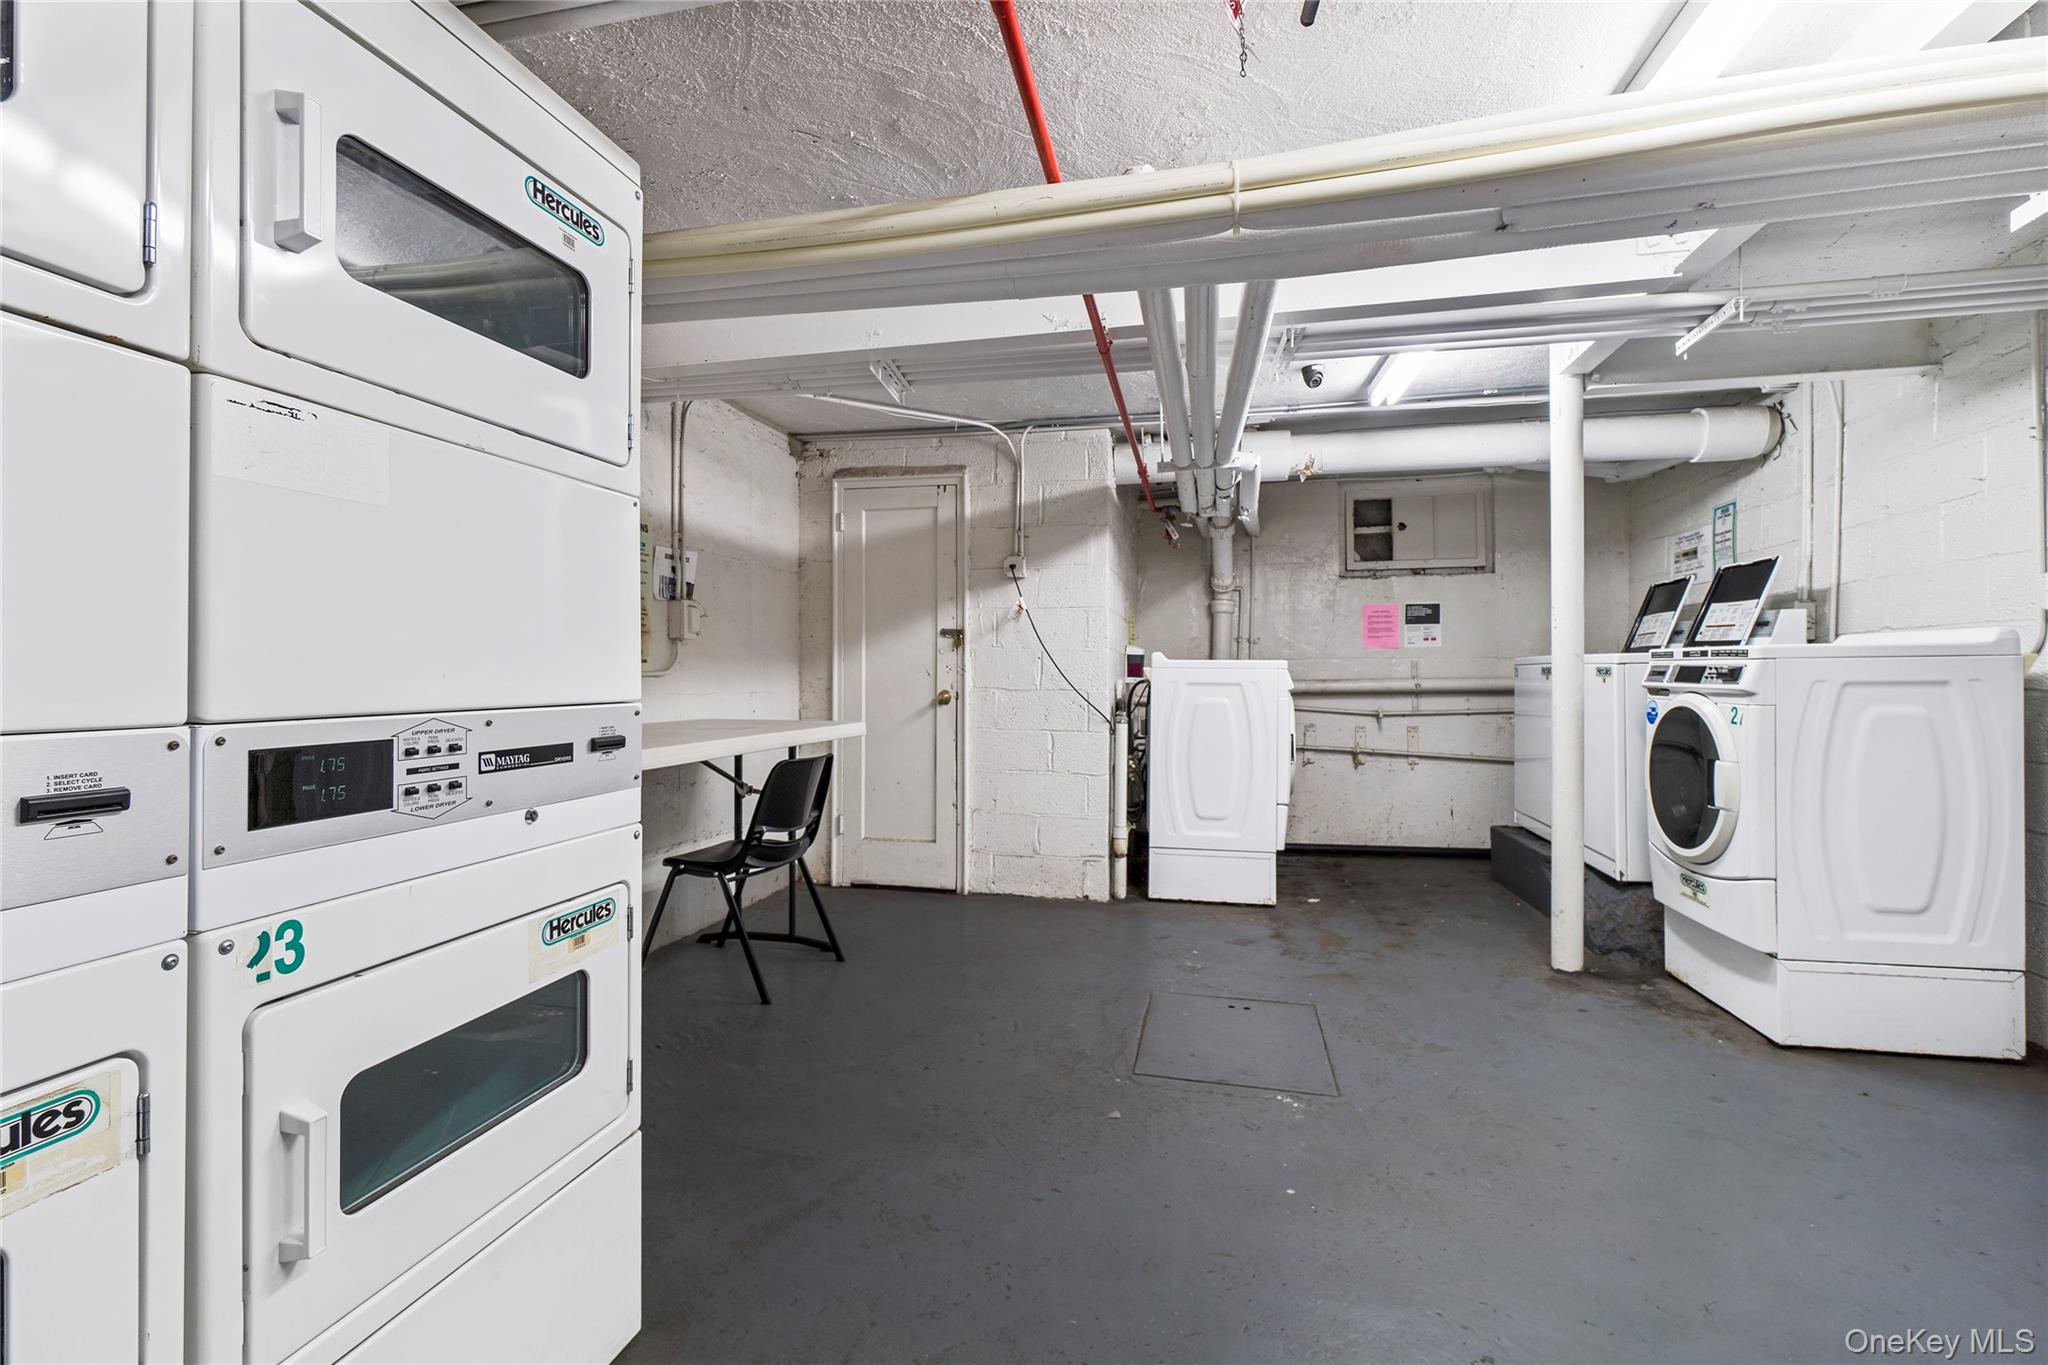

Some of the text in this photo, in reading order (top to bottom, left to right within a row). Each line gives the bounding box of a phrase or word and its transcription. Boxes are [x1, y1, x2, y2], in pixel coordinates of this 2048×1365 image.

[533, 178, 600, 241] Hercules
[496, 754, 530, 766] MAYTAG
[53, 779, 79, 787] SELECT
[53, 785, 82, 793] REMOVE
[410, 800, 457, 812] LOWER DRYER
[549, 903, 612, 940] Hercules
